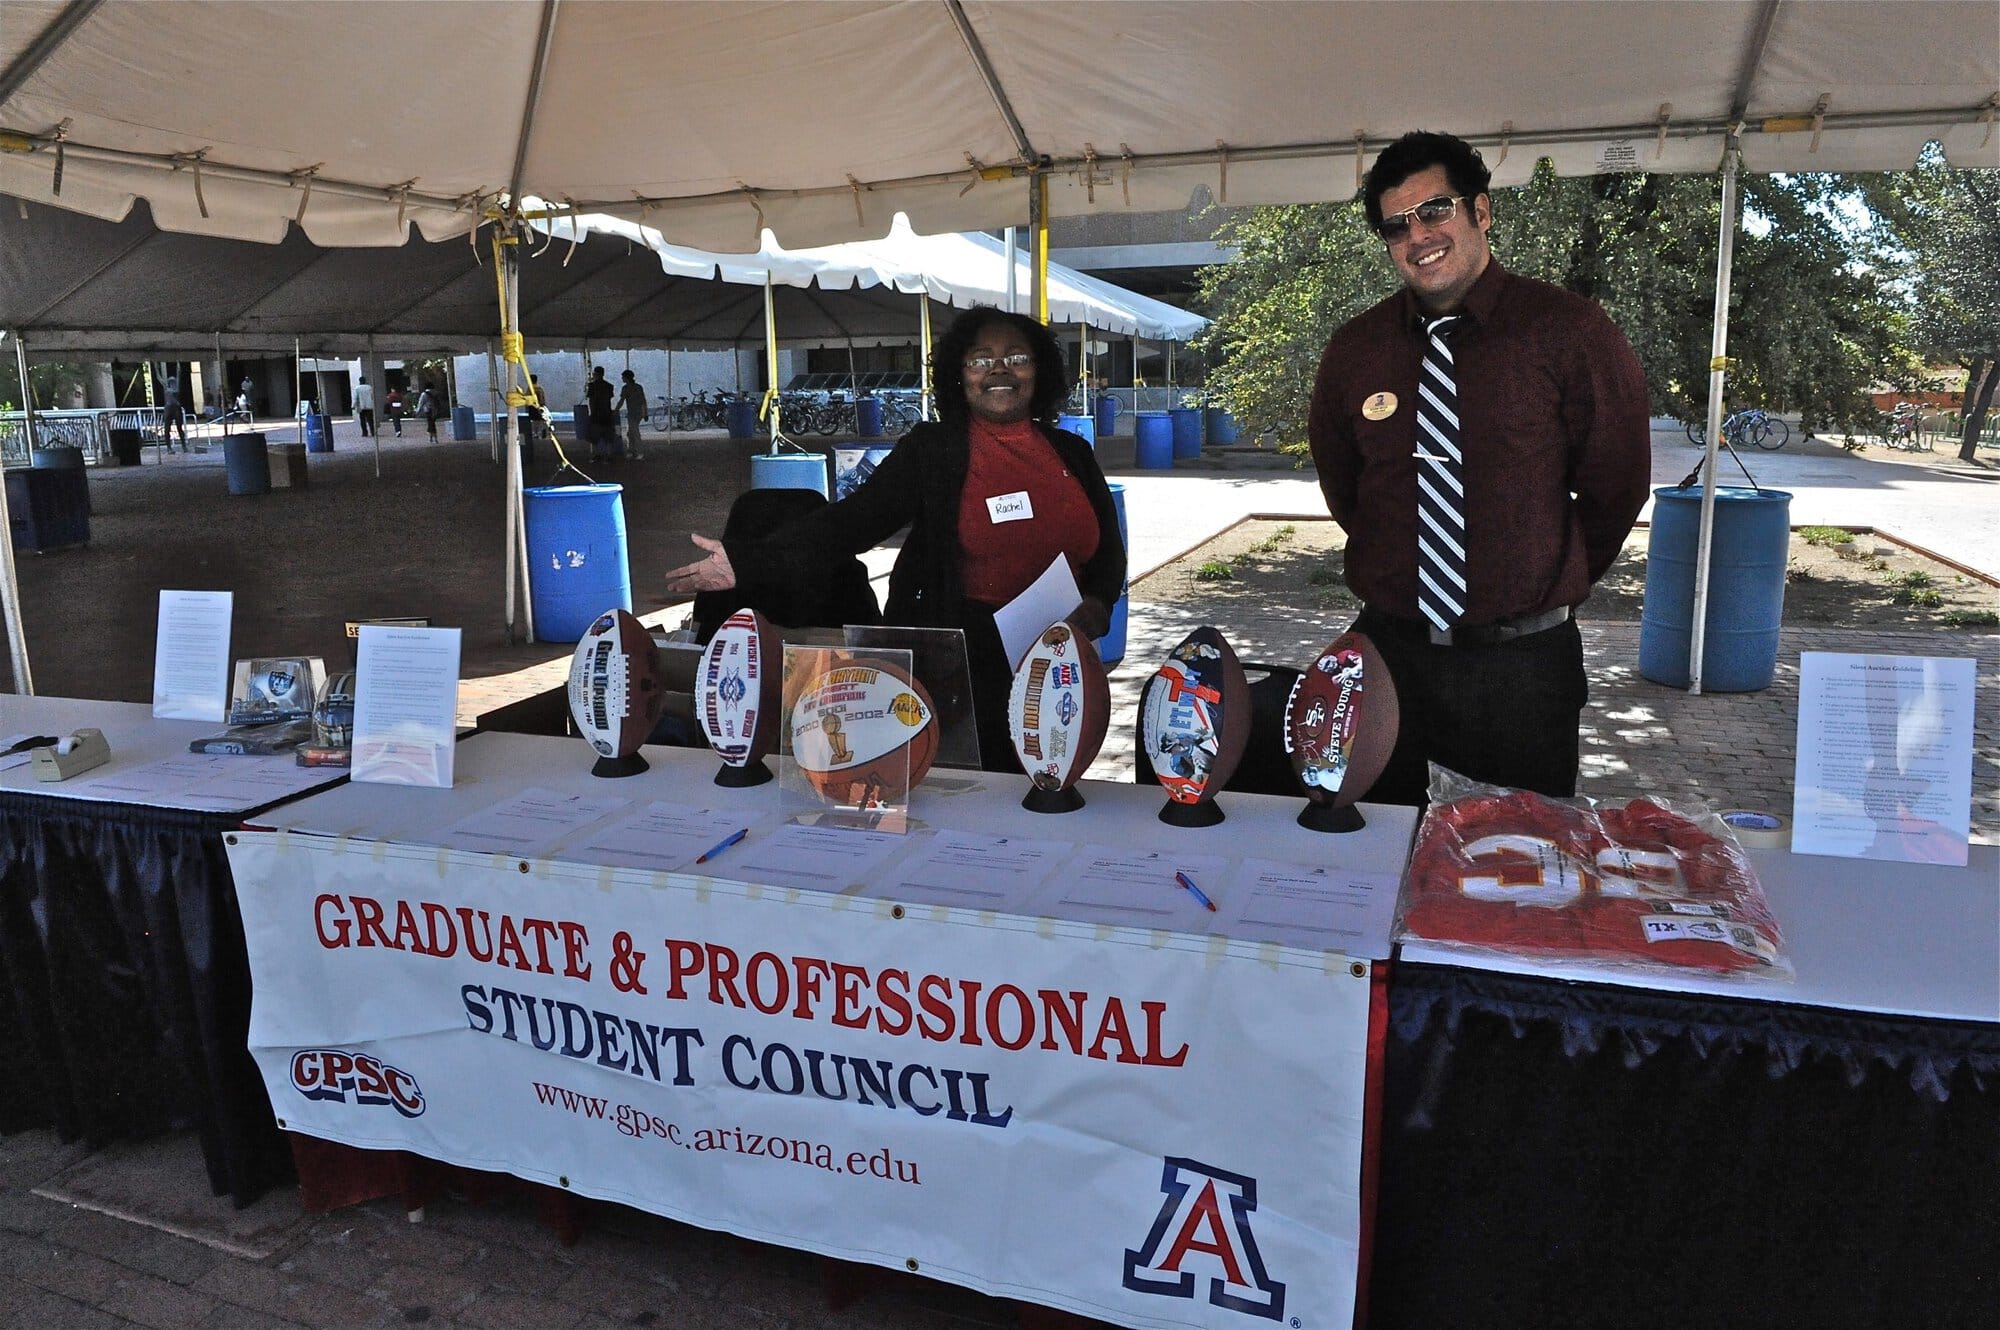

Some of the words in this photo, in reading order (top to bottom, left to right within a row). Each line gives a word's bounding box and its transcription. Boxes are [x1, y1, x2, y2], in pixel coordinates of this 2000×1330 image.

[995, 499, 1024, 515] Rachel
[595, 640, 614, 674] GENE
[747, 635, 757, 663] ENGLAND
[747, 664, 758, 679] NEW
[1060, 663, 1071, 686] XXIV
[1867, 664, 1891, 672] Auction
[582, 690, 590, 707] CLASS
[886, 697, 927, 720] LAKERS
[1169, 668, 1202, 730] ELWAY
[1332, 678, 1354, 720] YOUNG
[705, 692, 722, 737] WALTER
[844, 709, 884, 722] 2002
[1305, 702, 1325, 727] SF
[1023, 732, 1043, 761] JOE
[1328, 722, 1342, 764] STEVE
[1648, 922, 1678, 932] XL
[314, 893, 593, 983] GRADUATE
[609, 930, 647, 995] &
[665, 938, 1190, 1068] PROFESSIONAL
[460, 983, 705, 1087] STUDENT
[721, 1034, 1013, 1128] COUNCIL
[289, 1048, 426, 1119] GPSC
[532, 1081, 922, 1185] www.gpsc.arizona.edu
[1121, 1155, 1287, 1323] A
